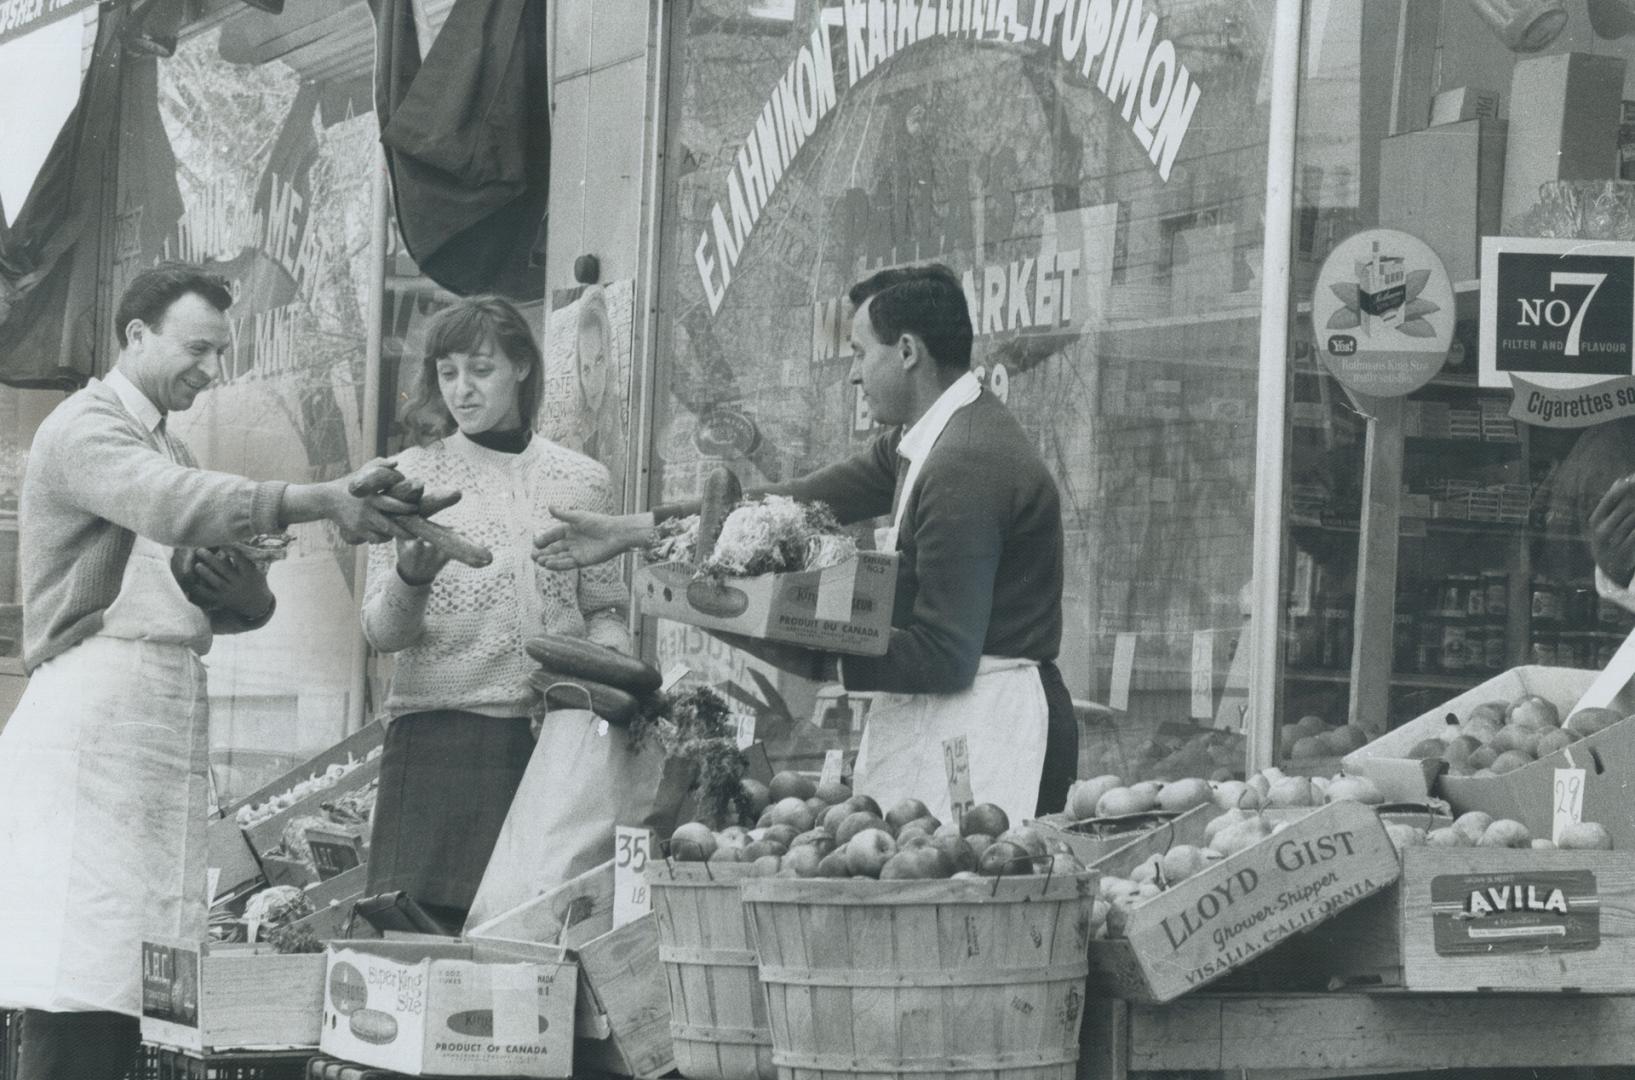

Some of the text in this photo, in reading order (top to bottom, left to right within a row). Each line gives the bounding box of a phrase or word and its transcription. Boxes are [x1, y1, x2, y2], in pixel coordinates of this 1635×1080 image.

[962, 249, 1080, 338] ARKET
[1502, 339, 1626, 352] FILTER AND FLAVOUR
[1527, 391, 1613, 422] Cigarettes
[779, 615, 818, 629] PRODUIT
[824, 621, 837, 632] DU
[842, 624, 879, 638] CANADA
[617, 833, 647, 873] 35
[1160, 831, 1354, 951] LLOYD GIST
[1470, 885, 1567, 913] AVILA
[1213, 871, 1339, 952] Grower-Shipper
[1263, 878, 1375, 943] CALIFORNIA
[396, 994, 422, 1015] Size
[435, 1042, 482, 1052] PRODUCT
[506, 1044, 548, 1055] CANADA
